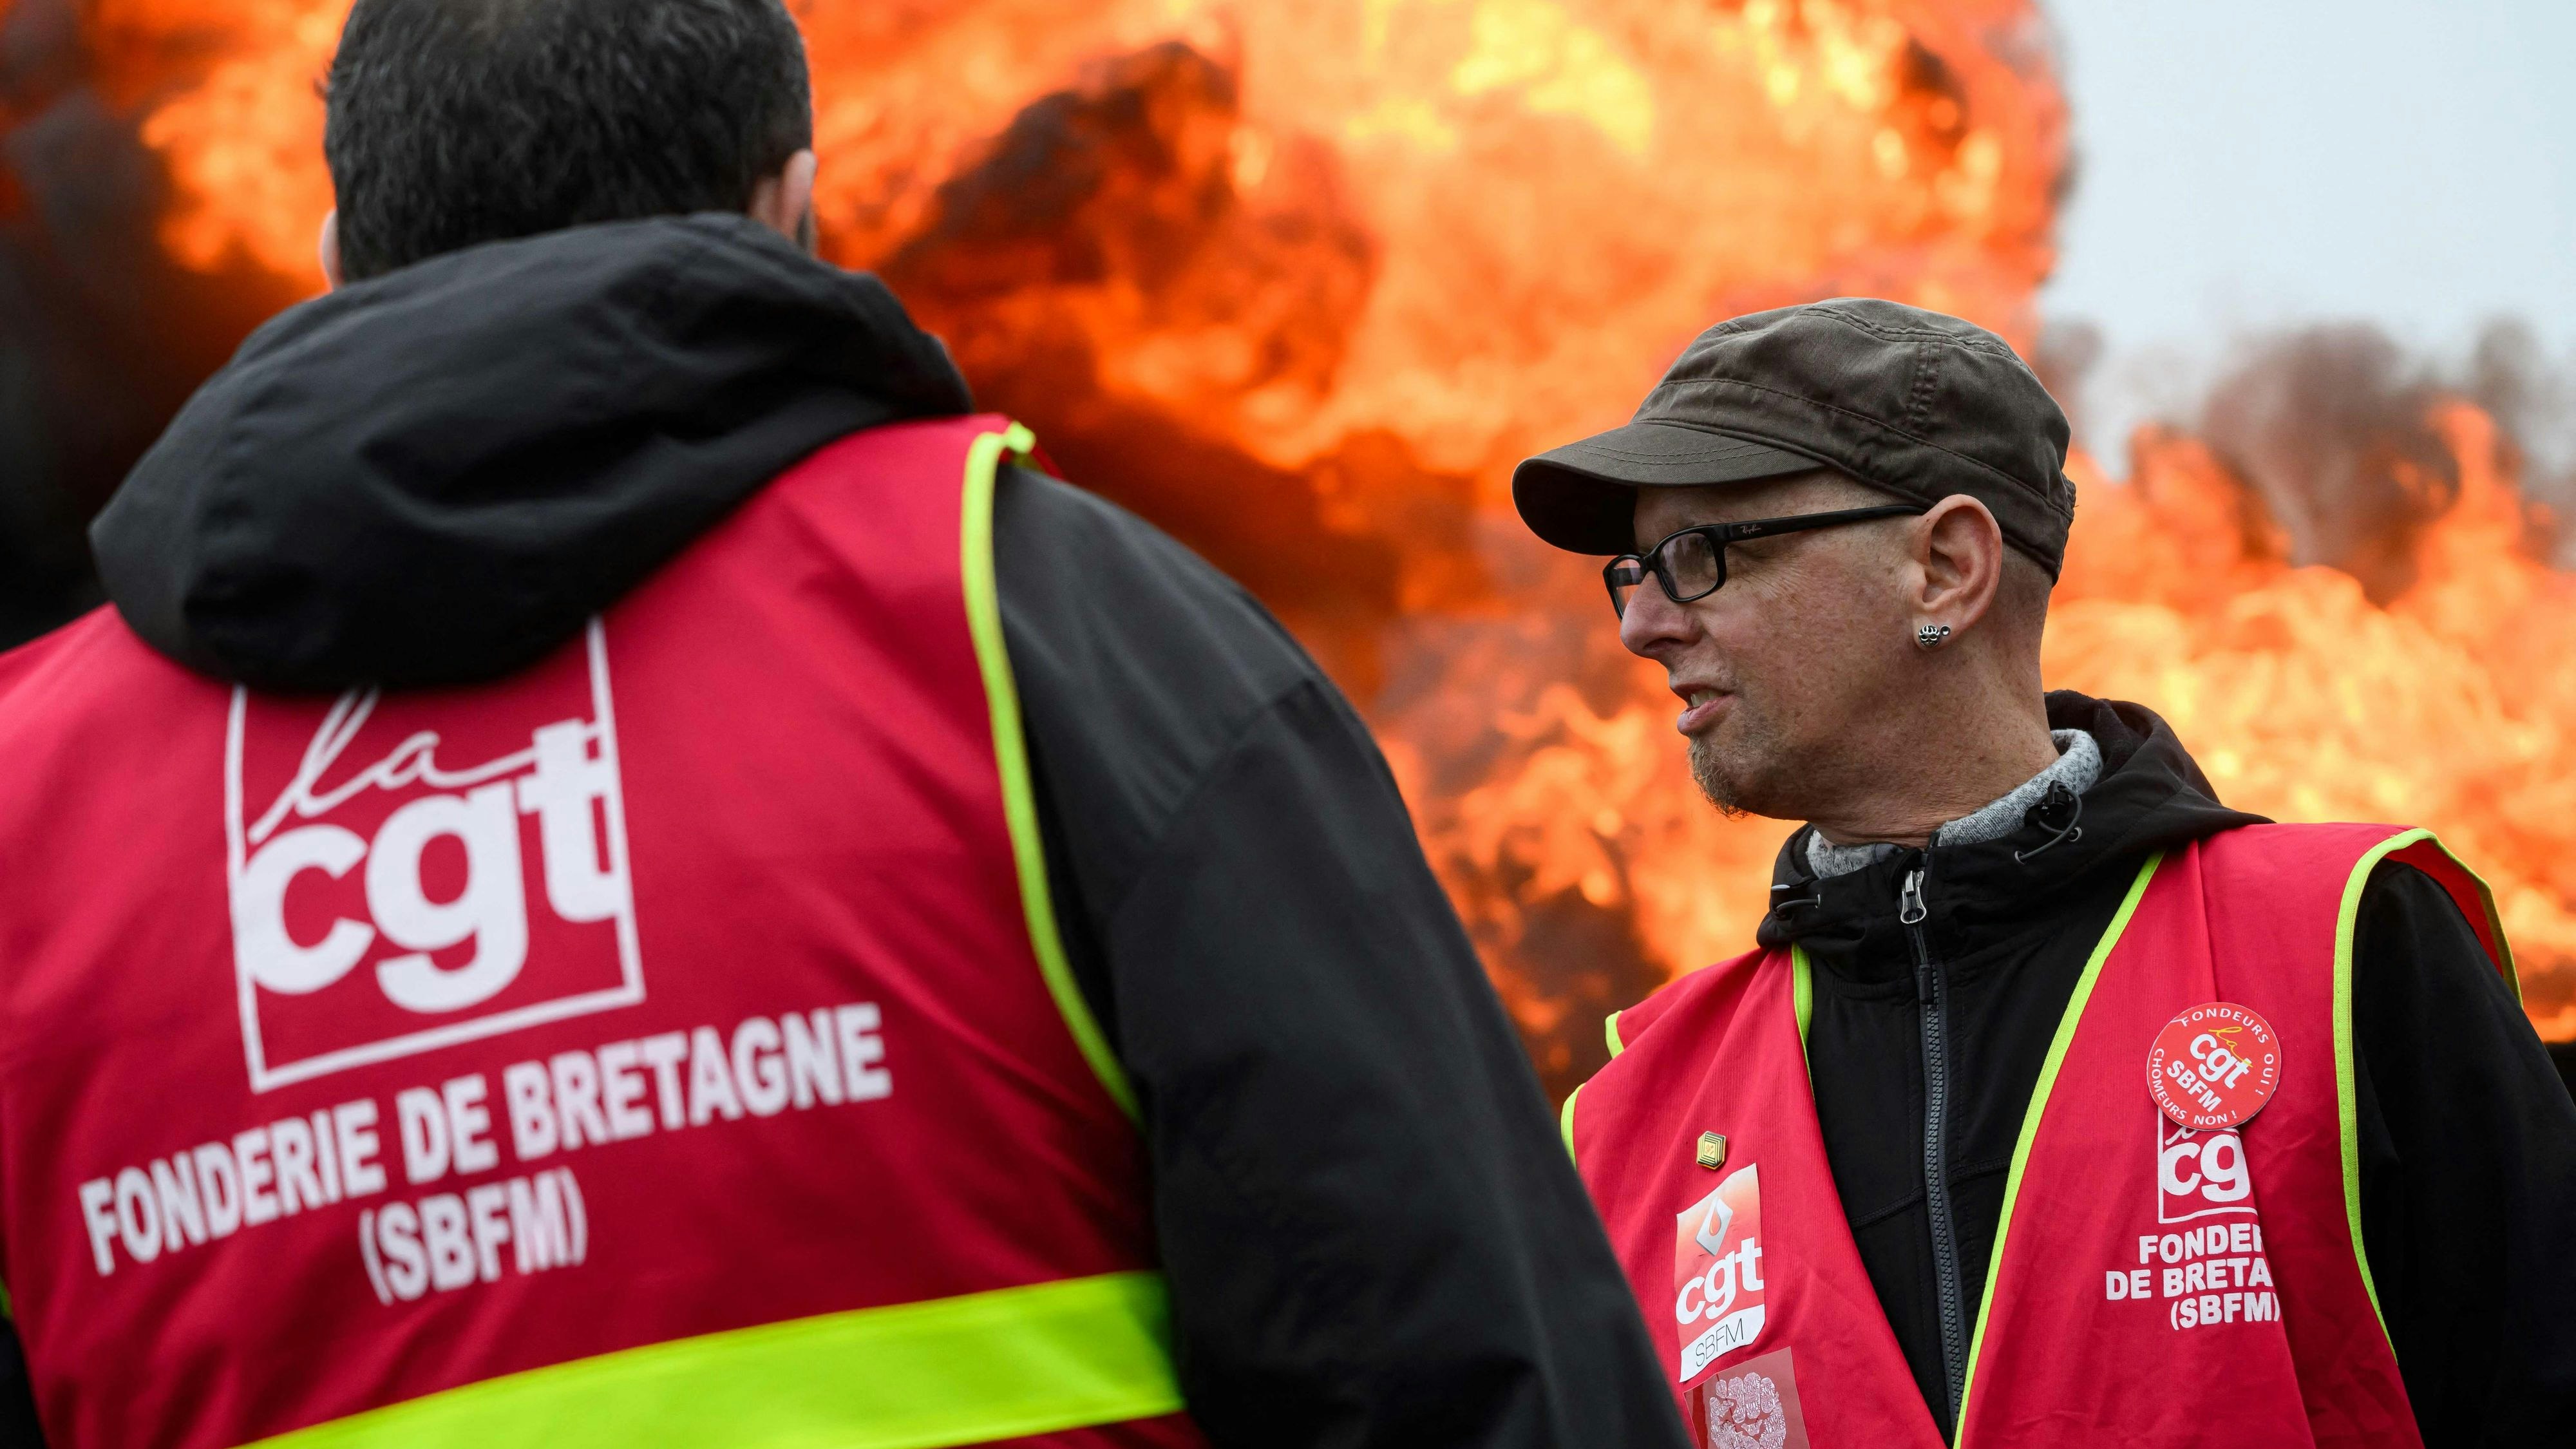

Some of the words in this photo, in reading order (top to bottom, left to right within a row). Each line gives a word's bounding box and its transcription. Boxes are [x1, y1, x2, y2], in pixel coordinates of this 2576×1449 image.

[233, 717, 622, 1014] cgt
[2181, 1008, 2269, 1043] FONDEURS
[2260, 1053, 2275, 1084] OUI
[2190, 1034, 2253, 1090] cgt
[2208, 1026, 2248, 1063] la
[2151, 1048, 2187, 1120] CHÔMEURS
[2193, 1113, 2228, 1125] NON
[2166, 1060, 2222, 1113] SBFM
[79, 1097, 386, 1276] FONDERIE
[395, 1074, 499, 1184] DE
[502, 1002, 893, 1161] BRETAGNE
[2161, 1134, 2251, 1202] cg
[358, 1166, 589, 1306] (SBFM)
[2139, 1223, 2263, 1264] FONDE
[1675, 1236, 1764, 1325] cgt
[2106, 1269, 2152, 1300] DE
[2163, 1257, 2274, 1298] BRETA
[2170, 1292, 2281, 1331] (SBFM)
[1695, 1318, 1745, 1368] SBFM
[1763, 1400, 1773, 1409] BIEN
